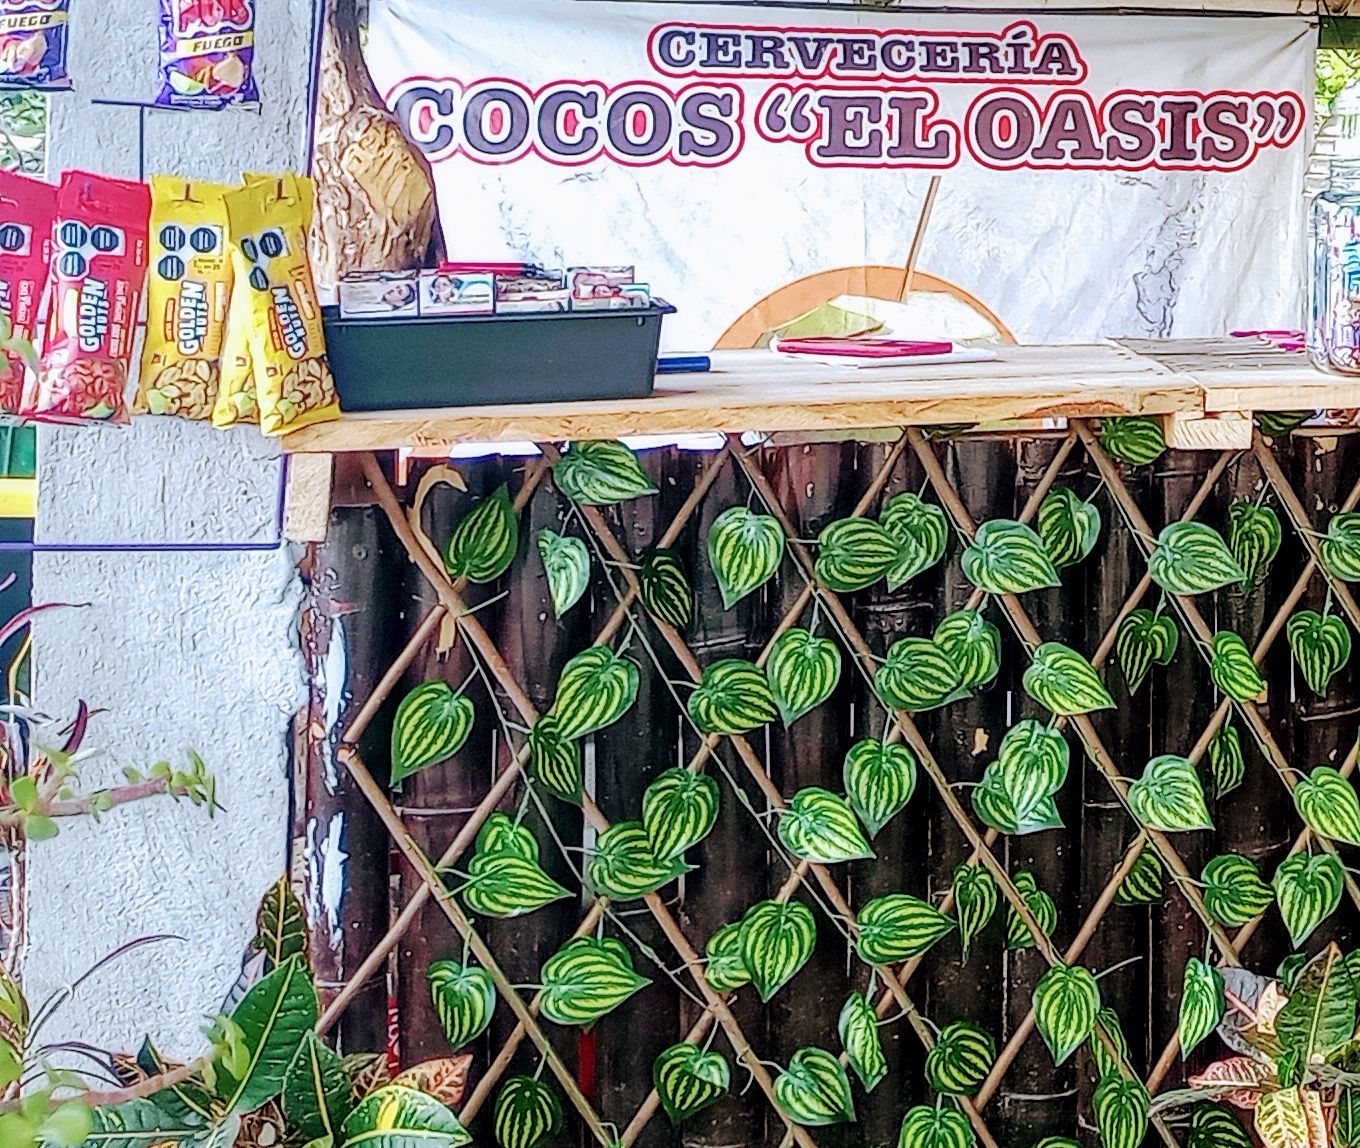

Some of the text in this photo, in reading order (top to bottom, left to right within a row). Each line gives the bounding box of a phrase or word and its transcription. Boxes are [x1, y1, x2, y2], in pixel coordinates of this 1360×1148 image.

[191, 34, 245, 53] FUEGO
[659, 22, 1079, 77] CERVECERÍA
[394, 88, 1302, 165] COCOS “EL OASIS”
[79, 278, 107, 352] GOLDEN
[177, 280, 207, 356] GOLDEN
[271, 285, 306, 361] GOLDEN
